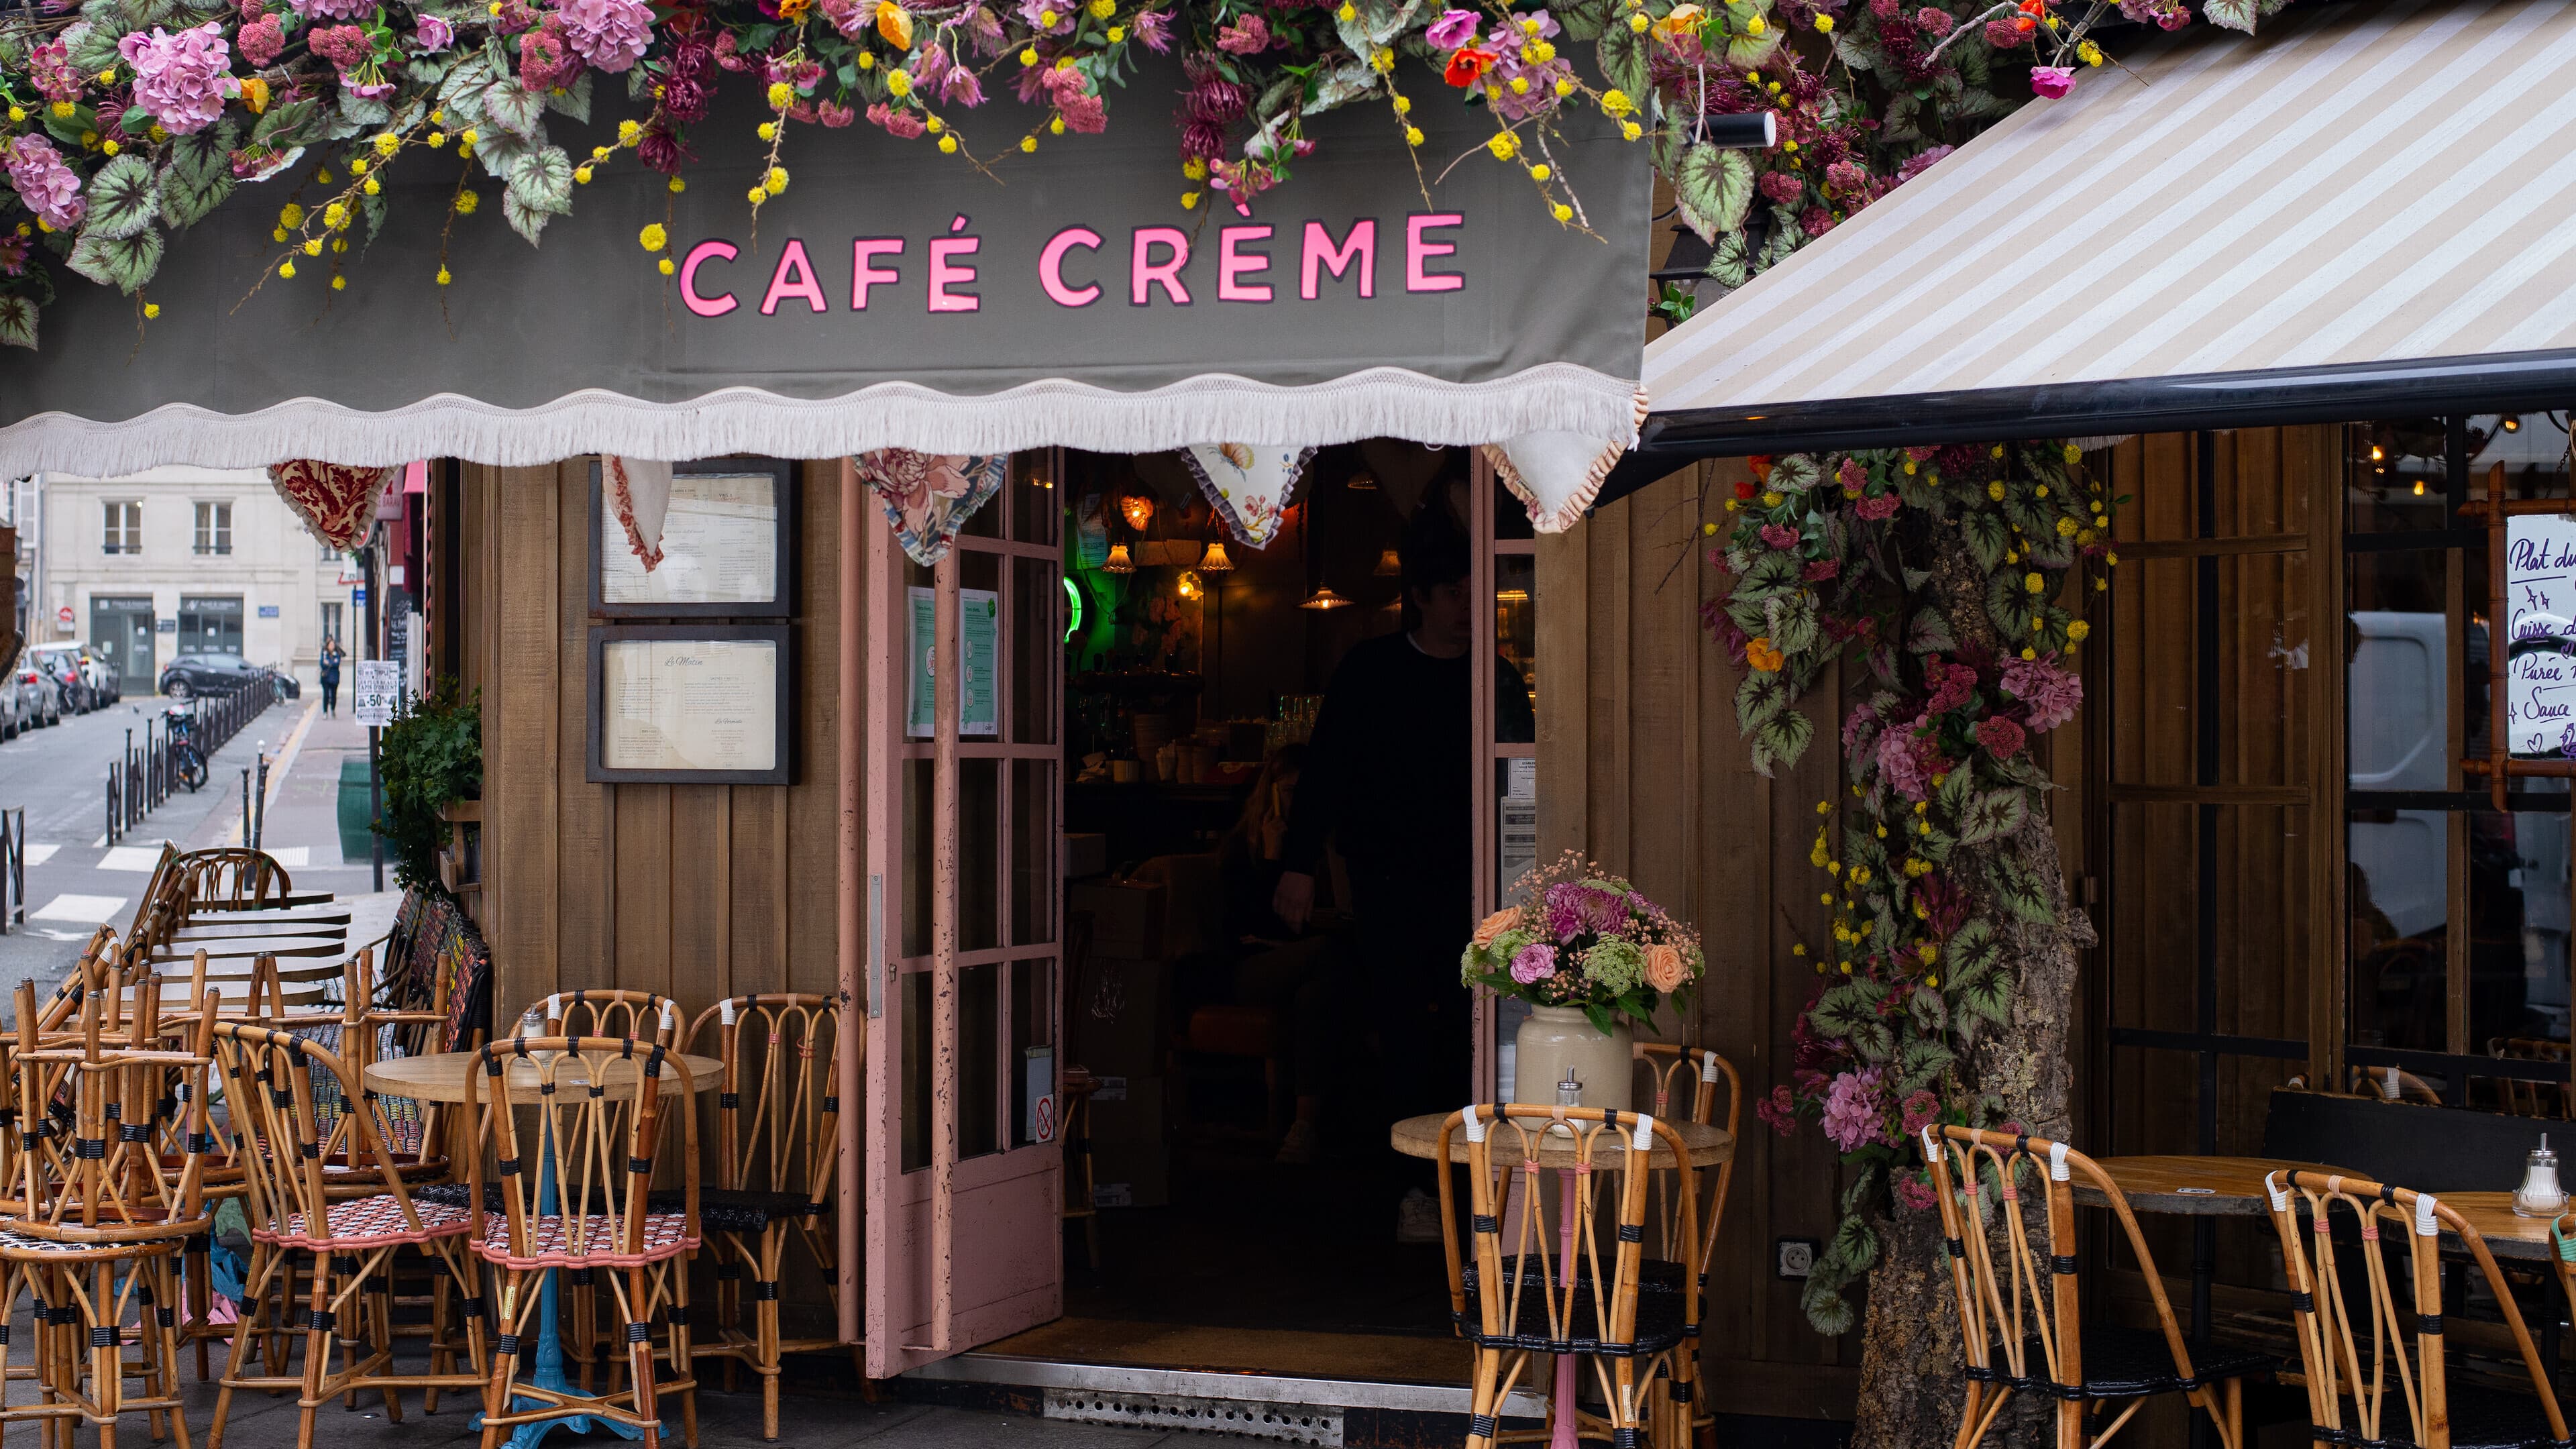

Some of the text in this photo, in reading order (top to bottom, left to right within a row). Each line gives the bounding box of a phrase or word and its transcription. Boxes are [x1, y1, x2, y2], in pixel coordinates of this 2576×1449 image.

[679, 201, 1466, 318] CAFÉ CRÈME
[2509, 538, 2551, 571] Plat
[2511, 608, 2554, 640] Cuisse
[676, 655, 703, 666] Matin
[2514, 651, 2563, 681] Purée
[2524, 686, 2571, 720] Sauce
